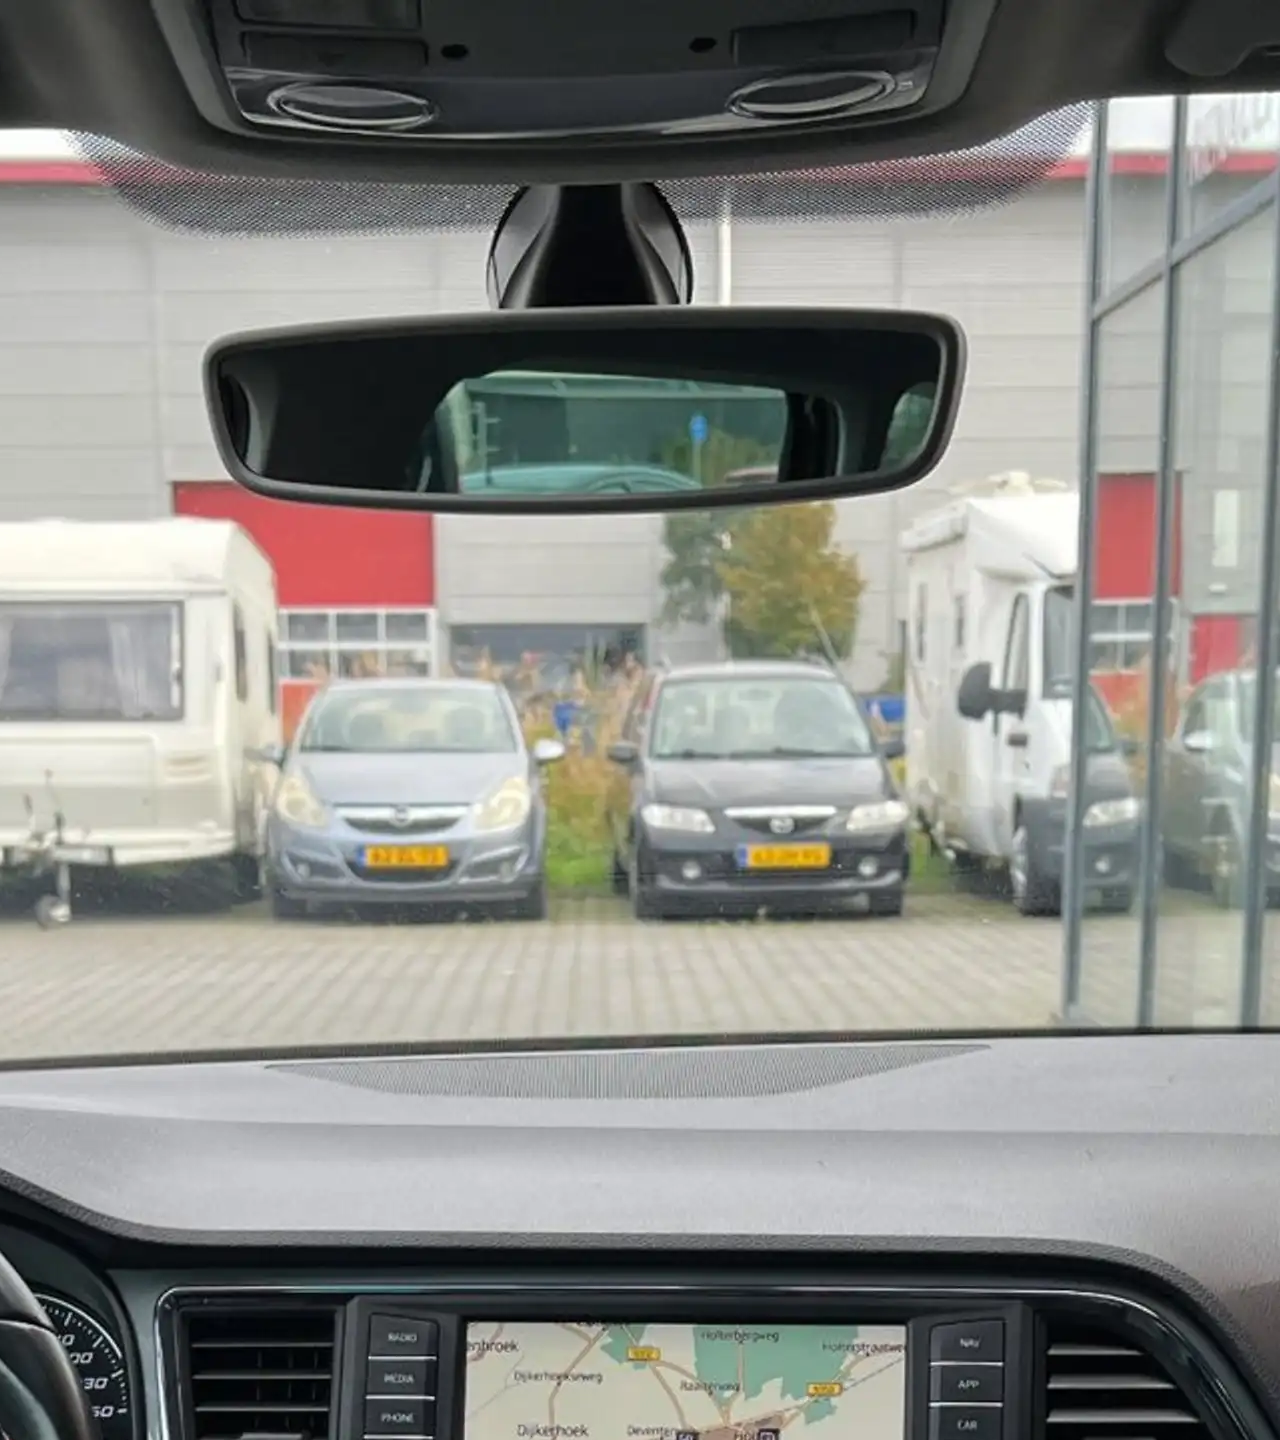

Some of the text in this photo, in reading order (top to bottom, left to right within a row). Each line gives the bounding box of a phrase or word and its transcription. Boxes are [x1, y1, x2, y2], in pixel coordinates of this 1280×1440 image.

[387, 1332, 418, 1343] RADIO
[83, 1377, 109, 1390] 30
[383, 1373, 414, 1384] MEDIA
[957, 1379, 980, 1389] APP
[381, 1413, 414, 1424] PHONE
[956, 1419, 978, 1431] CAR
[517, 1424, 589, 1440] Dijkerhoek
[627, 1425, 676, 1437] Deventer
